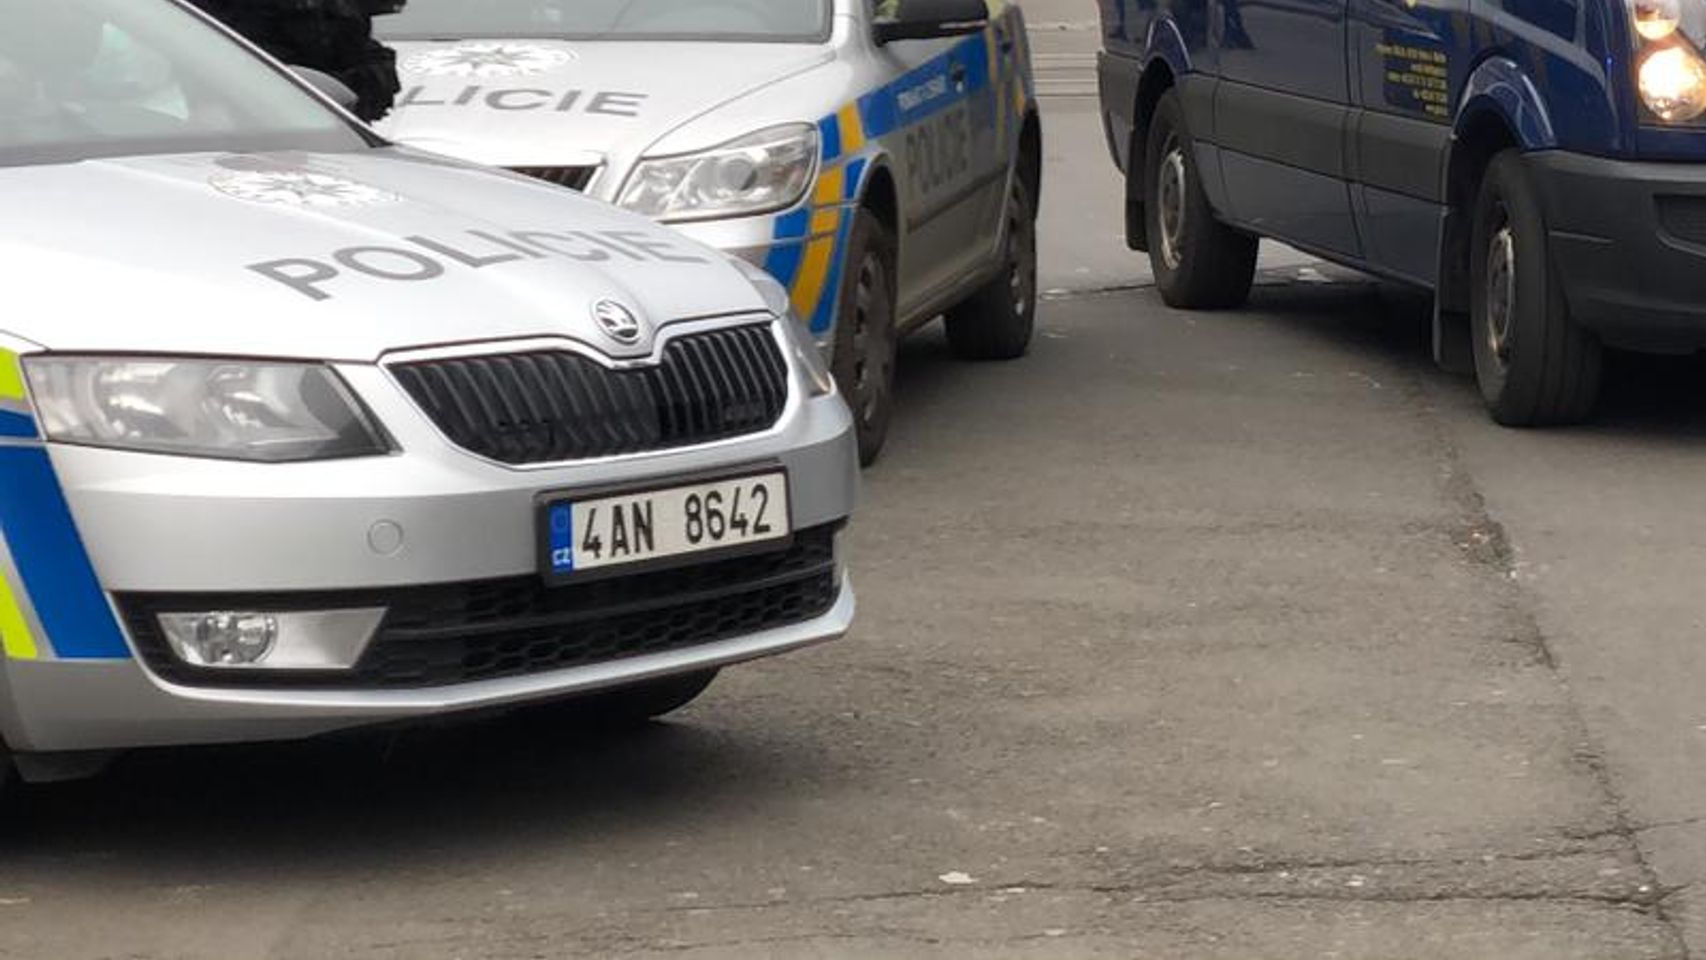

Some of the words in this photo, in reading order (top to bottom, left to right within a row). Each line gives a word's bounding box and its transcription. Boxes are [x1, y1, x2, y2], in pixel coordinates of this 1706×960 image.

[398, 85, 649, 117] LICIE
[245, 230, 711, 301] POLICIE
[552, 547, 571, 567] CZ
[582, 500, 655, 558] 4AN
[684, 483, 772, 545] 8642
